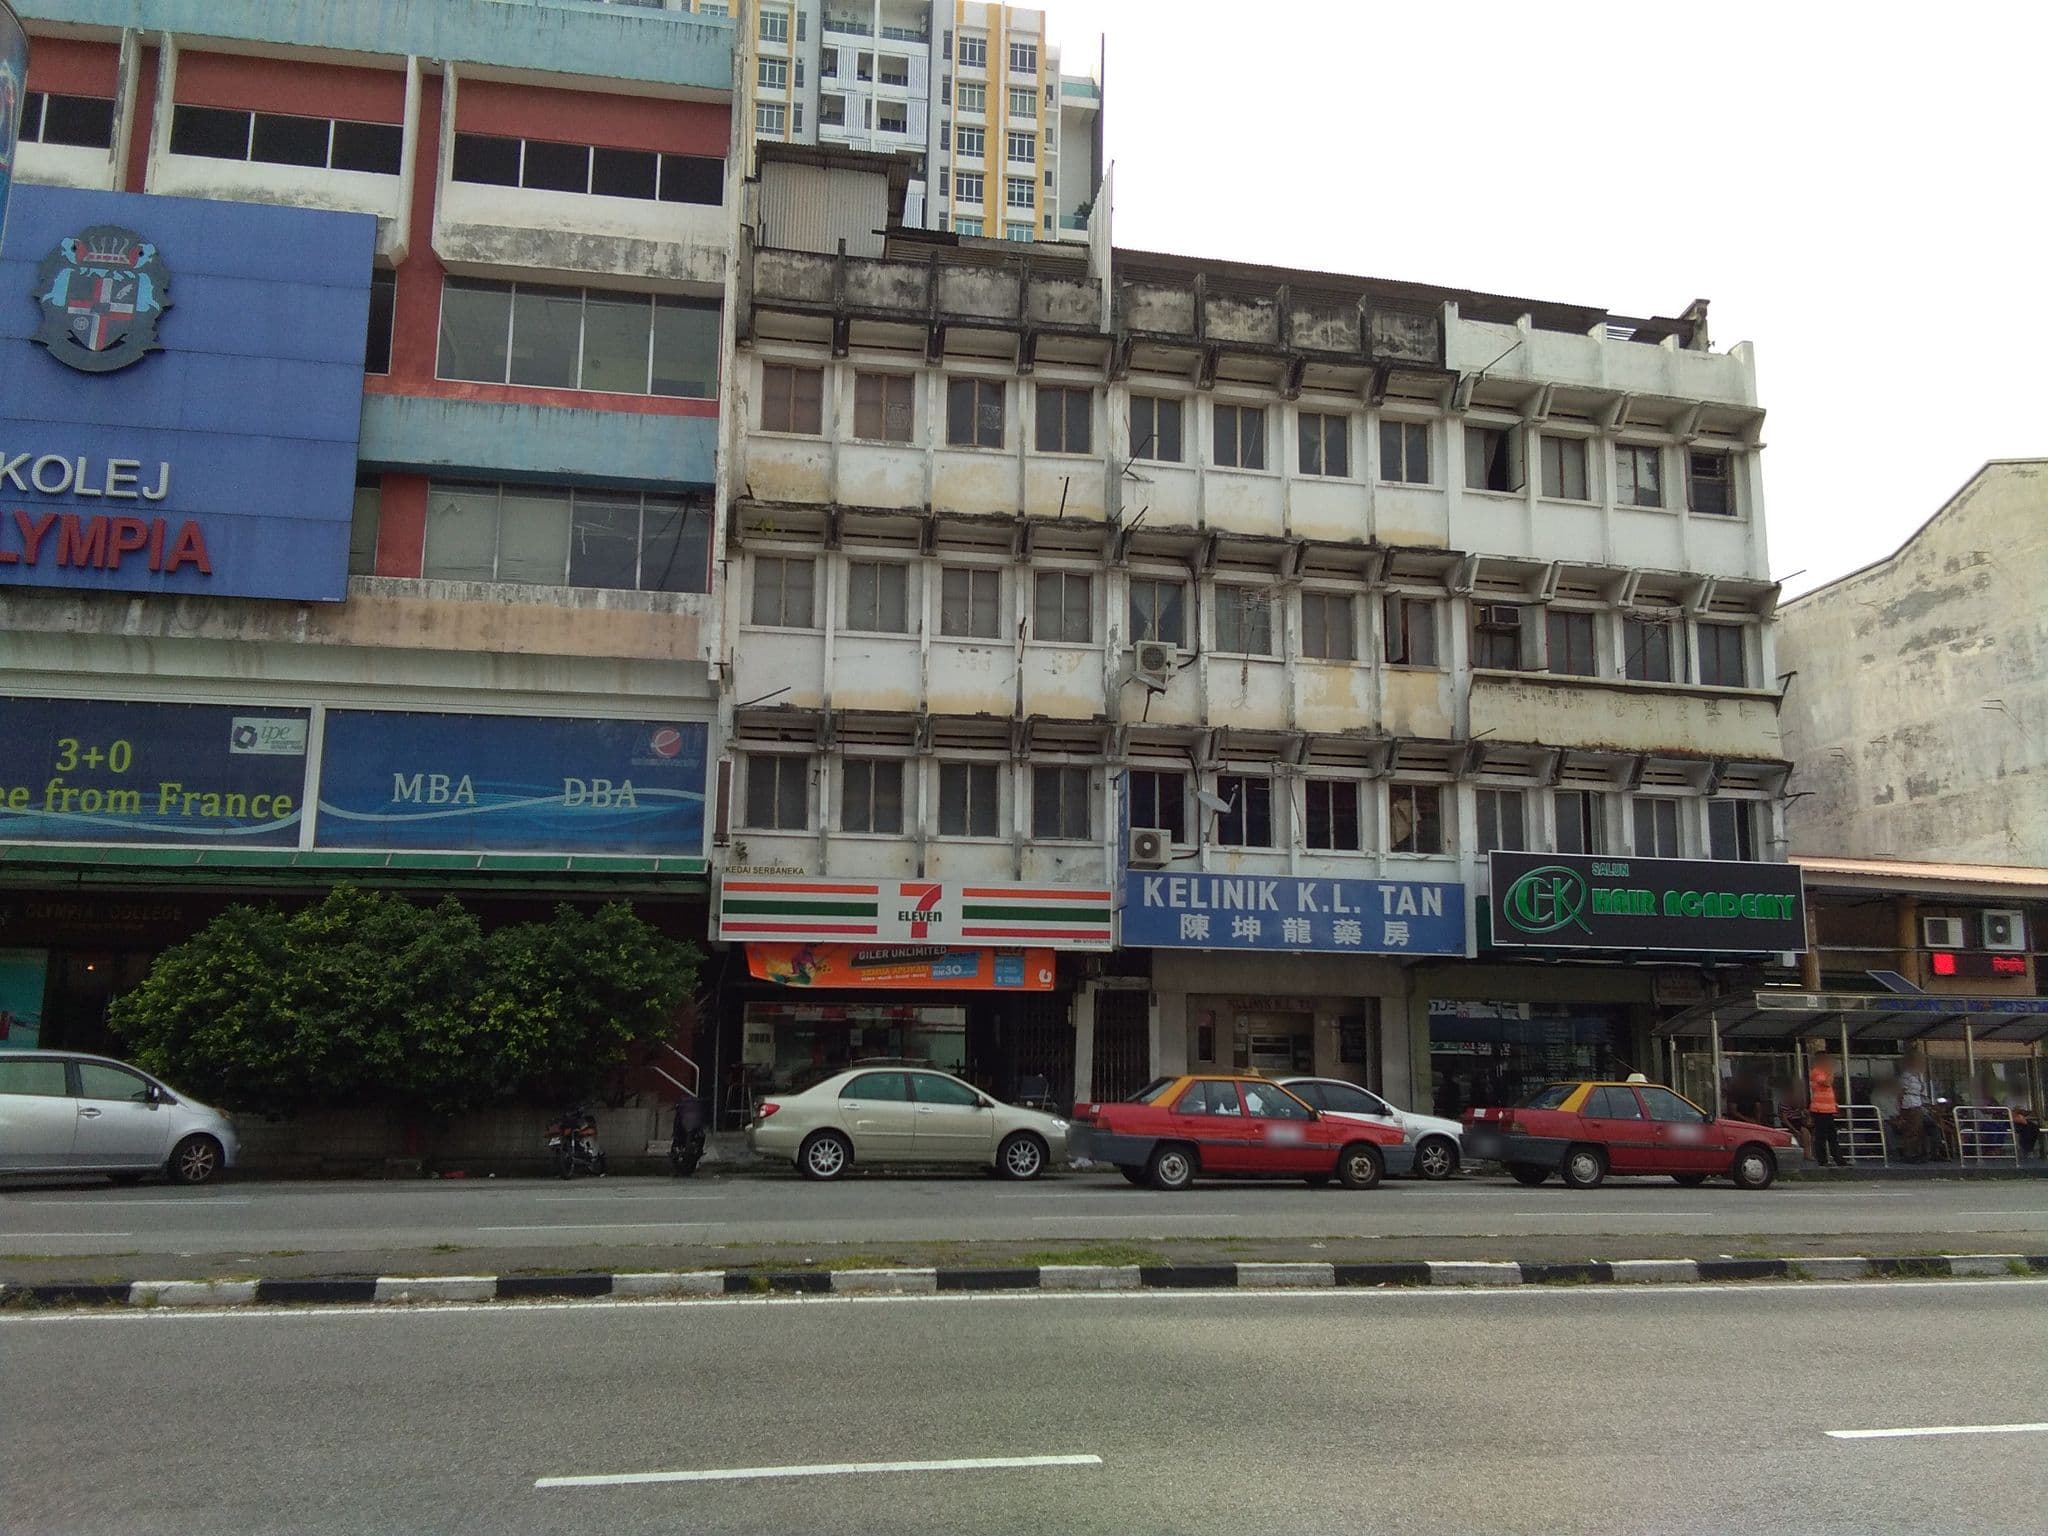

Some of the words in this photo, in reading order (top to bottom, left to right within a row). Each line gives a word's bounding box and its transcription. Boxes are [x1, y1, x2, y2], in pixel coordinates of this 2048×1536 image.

[0, 452, 170, 500] KOLEJ
[55, 738, 132, 773] 3+0
[44, 777, 140, 815] from
[157, 782, 293, 819] France
[392, 772, 478, 805] MBA
[562, 777, 639, 809] DBA
[725, 865, 751, 874] KEDAI
[752, 866, 805, 875] SERBANEKA
[900, 883, 942, 938] 7
[1143, 876, 1279, 911] KELINIK
[1298, 885, 1361, 914] K.L.
[1378, 885, 1442, 916] TAN
[1592, 888, 1657, 915] HAIR
[1664, 891, 1795, 920] ACADEMY
[1180, 913, 1410, 946] 陳坤龍藥房
[891, 946, 947, 957] UNLIMITED
